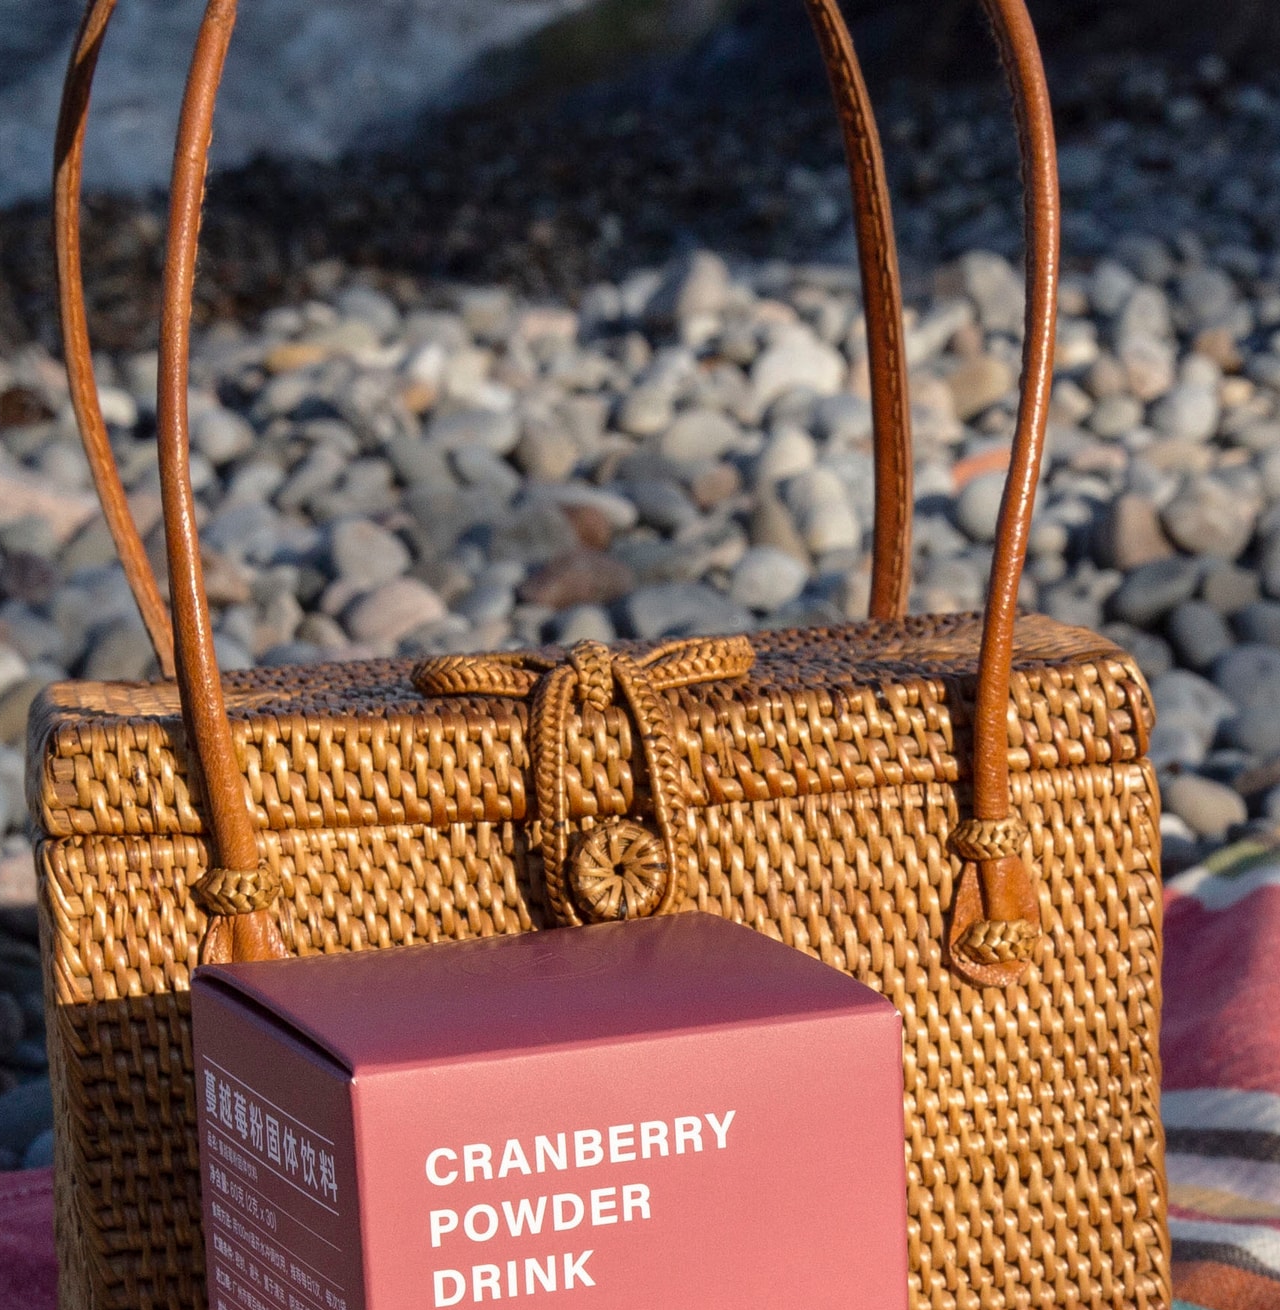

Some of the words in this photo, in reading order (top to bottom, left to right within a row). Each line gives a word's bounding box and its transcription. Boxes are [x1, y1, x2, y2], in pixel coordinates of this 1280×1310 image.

[203, 1068, 338, 1207] 蔓越莓粉固体饮料
[425, 1110, 737, 1186] CRANBERRY
[229, 1178, 244, 1208] 60克
[430, 1183, 651, 1248] POWDER
[433, 1250, 596, 1308] DRINK
